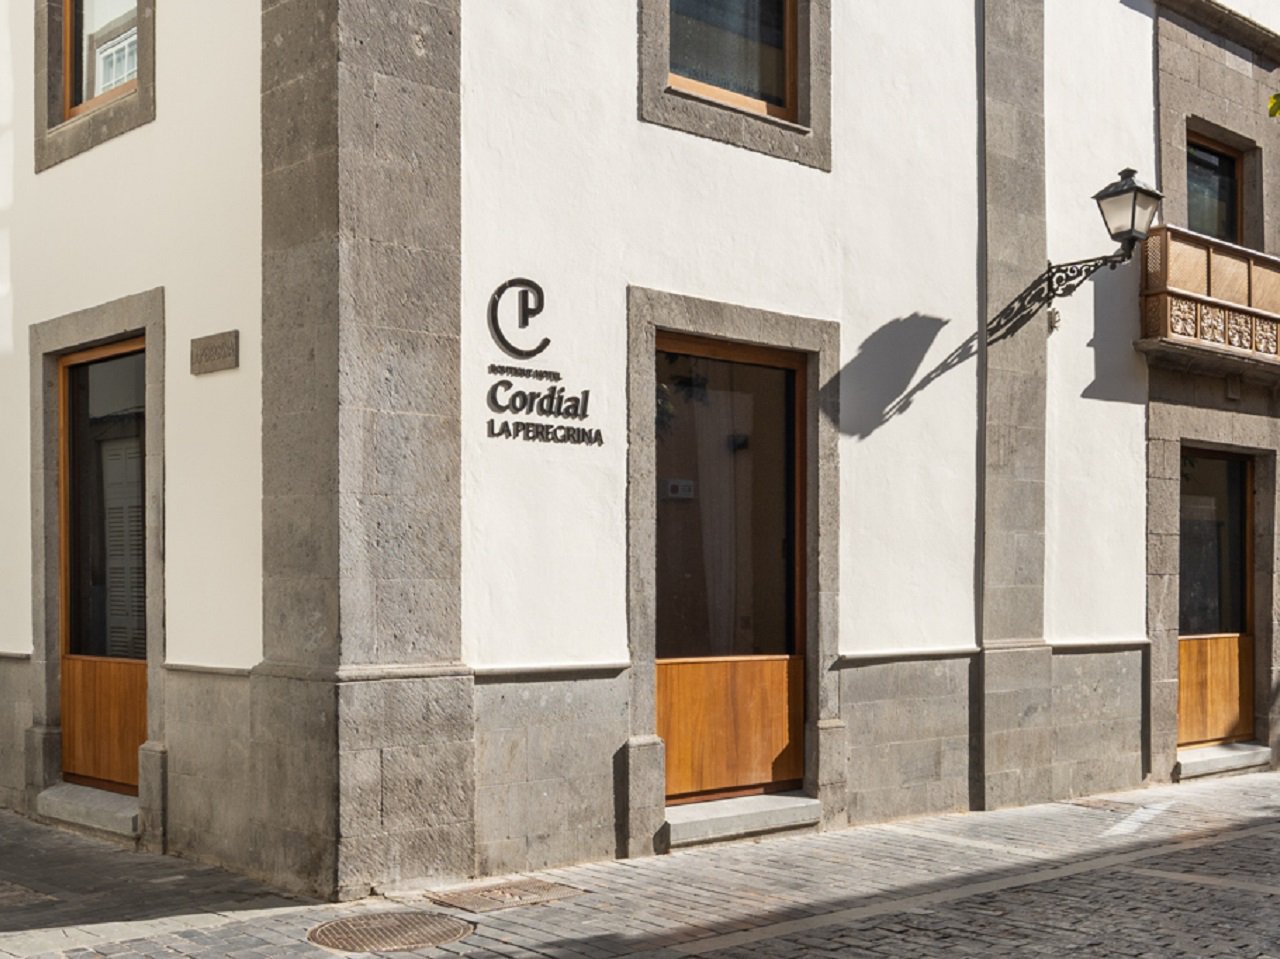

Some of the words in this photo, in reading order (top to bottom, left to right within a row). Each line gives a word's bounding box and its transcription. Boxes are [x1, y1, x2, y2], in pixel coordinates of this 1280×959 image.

[487, 379, 590, 421] Cordial
[487, 418, 512, 439] LA
[513, 421, 604, 447] PEREGRINA
